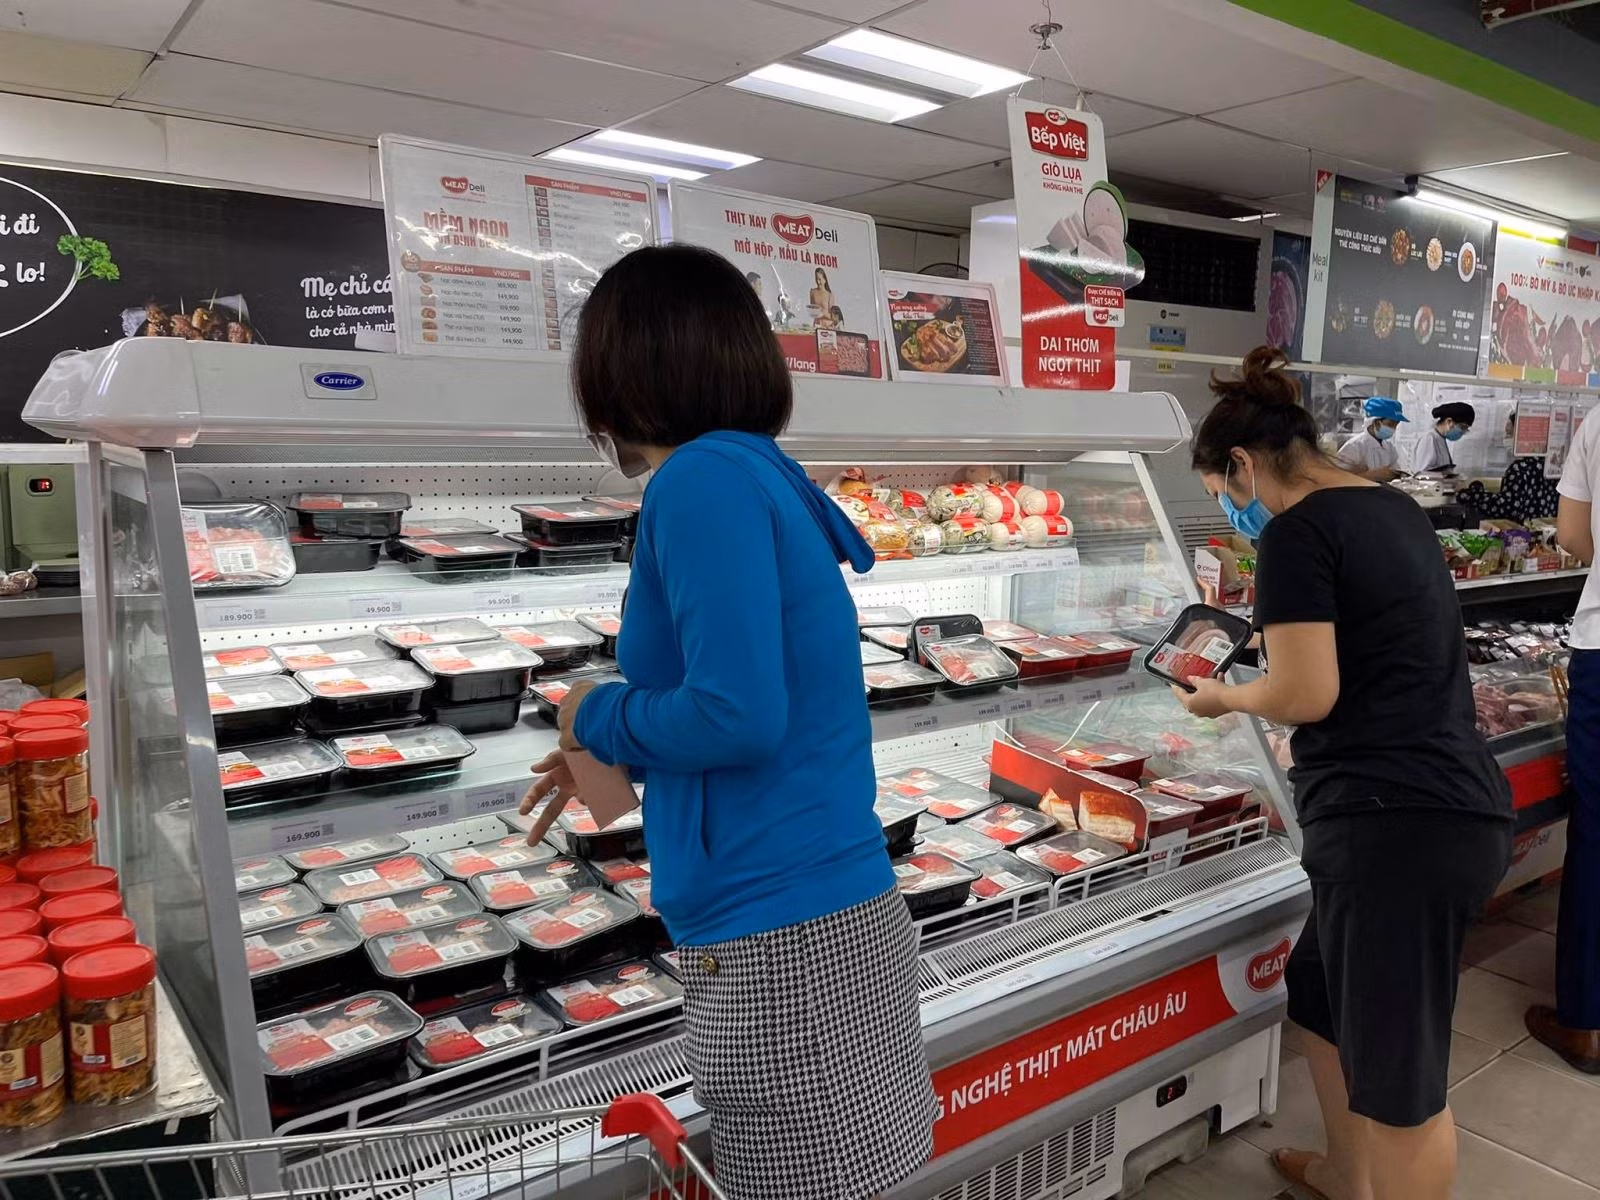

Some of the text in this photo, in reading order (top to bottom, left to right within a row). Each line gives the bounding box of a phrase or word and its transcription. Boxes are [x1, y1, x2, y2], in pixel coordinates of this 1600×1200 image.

[1031, 126, 1086, 155] Bếp Việt
[1041, 162, 1082, 183] GIÒ LỤA
[445, 181, 486, 193] MEAT Deli
[13, 213, 40, 235] đi
[423, 208, 509, 238] MỀM NGON
[725, 209, 838, 243] THỊT XAY MEAT Deli
[734, 238, 752, 254] MỞ
[779, 244, 798, 261] NẤU
[800, 247, 812, 264] LÀ
[813, 256, 838, 269] NGON
[1312, 252, 1329, 267] Meal
[16, 262, 46, 283] lo!
[1511, 272, 1528, 288] 100%
[300, 276, 338, 301] Mẹ
[339, 273, 371, 296] chỉ
[305, 306, 320, 319] là
[320, 305, 336, 318] có
[336, 304, 362, 317] bữa
[362, 305, 387, 315] cơm
[1104, 297, 1119, 308] SẠCH
[309, 325, 331, 338] cho
[332, 322, 348, 336] cả
[1040, 335, 1099, 353] DAI THƠM
[1038, 356, 1102, 377] NGỌT THỊT
[321, 375, 359, 386] Carrier
[476, 798, 505, 810] 149.900
[406, 809, 437, 822] 149.900
[286, 829, 321, 844] 169.900
[1253, 952, 1287, 982] MEAT
[951, 1061, 1012, 1115] NGHỆ
[1017, 1044, 1062, 1084] THỊT
[1065, 1025, 1107, 1063] MÁT
[1110, 1004, 1160, 1042] CHÂU
[1162, 990, 1187, 1020] ÂU
